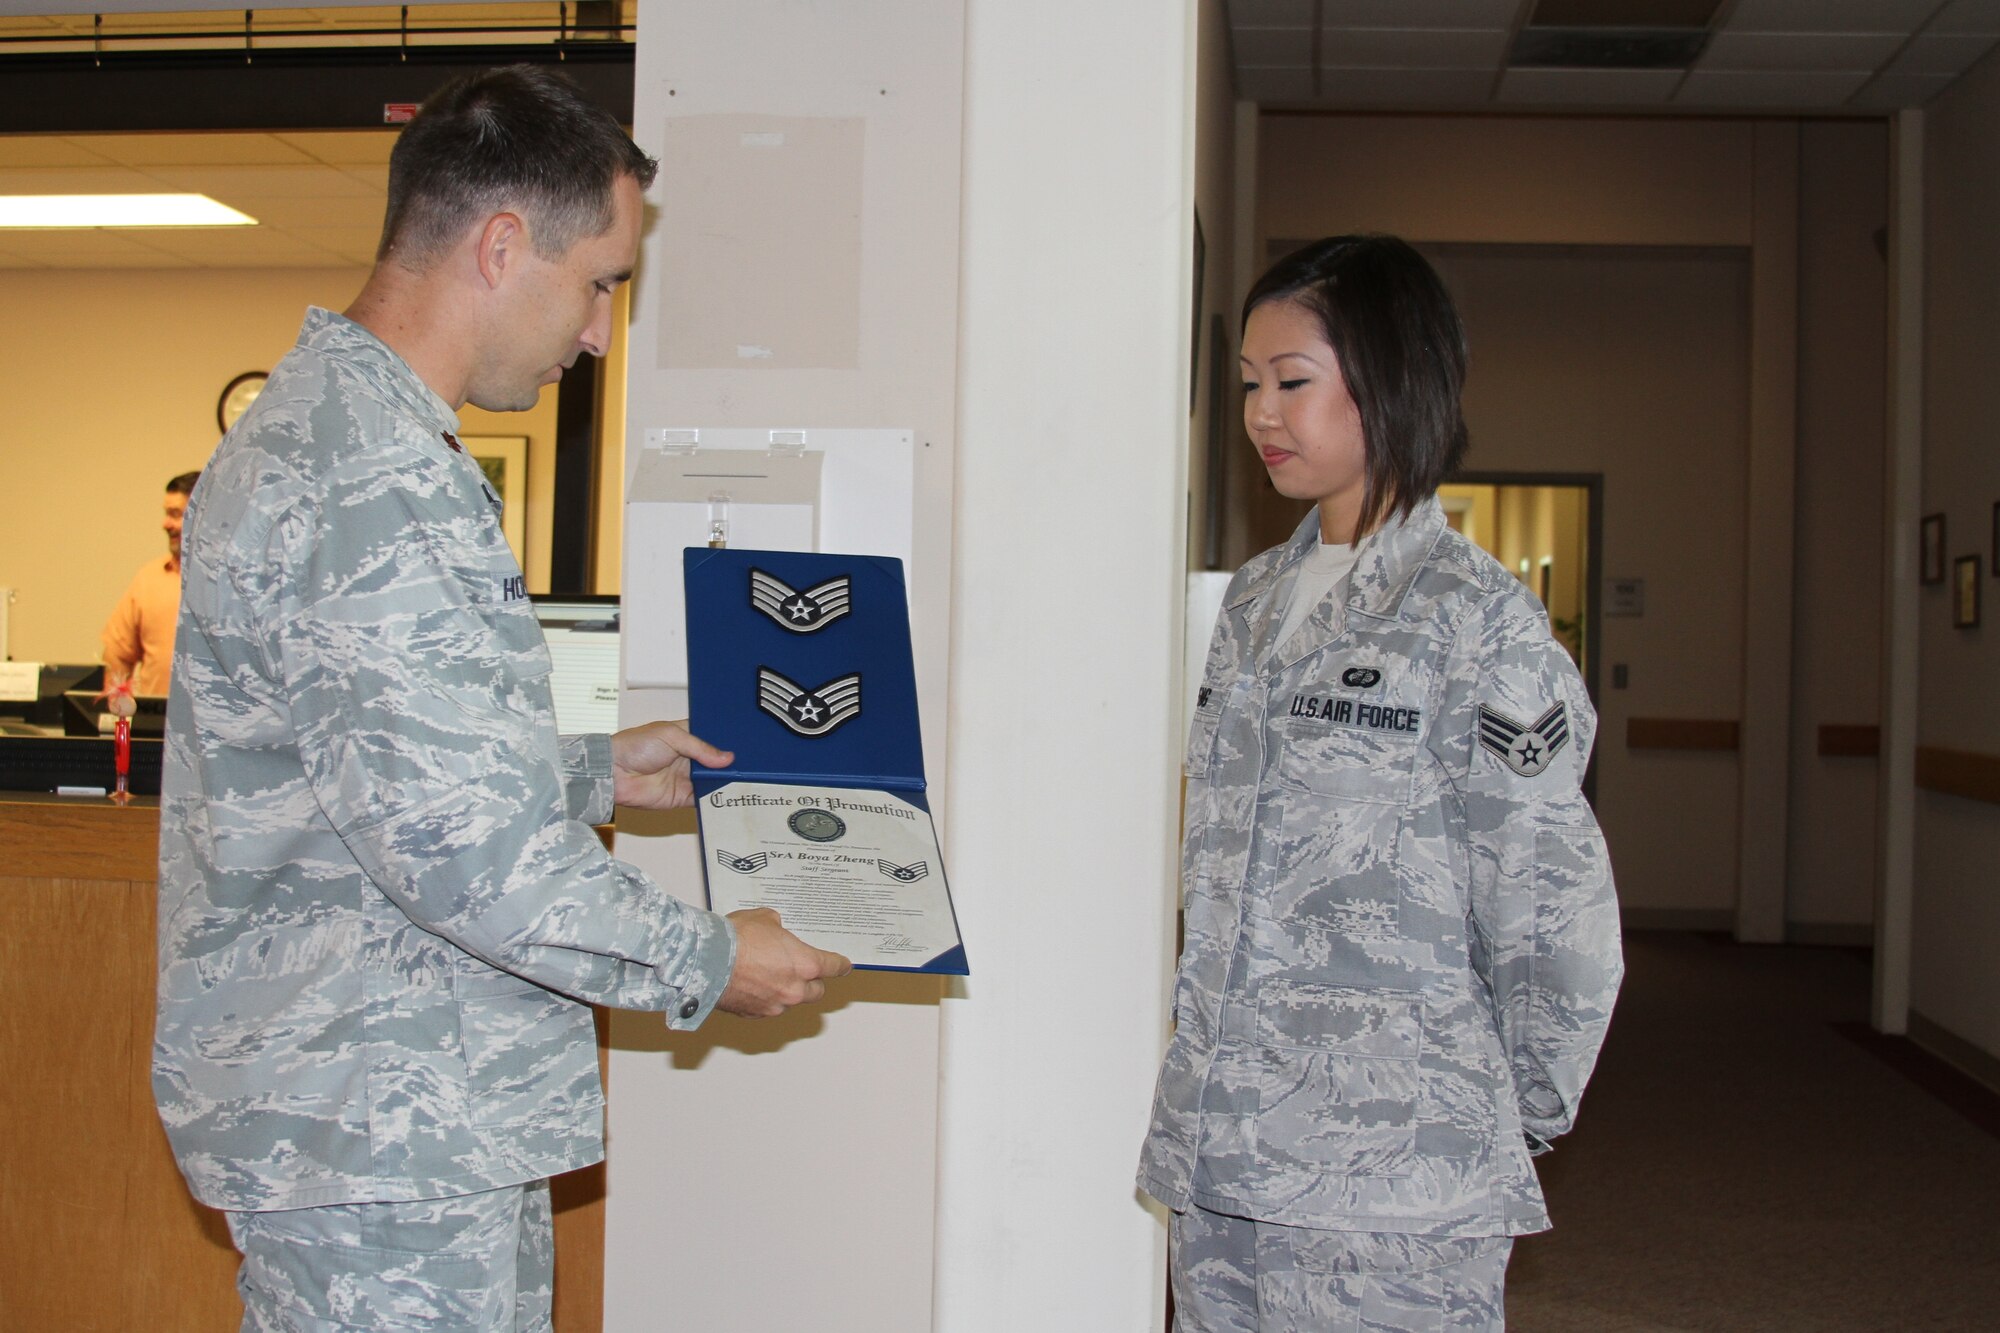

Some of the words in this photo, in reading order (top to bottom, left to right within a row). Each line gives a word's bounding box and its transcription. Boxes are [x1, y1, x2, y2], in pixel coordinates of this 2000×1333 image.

[1357, 703, 1420, 732] FORCE
[710, 791, 793, 808] Certificate
[797, 796, 820, 807] Of
[825, 797, 916, 821] Promotion
[768, 850, 793, 860] SrA
[797, 852, 830, 863] Boya
[833, 854, 875, 866] Zheng
